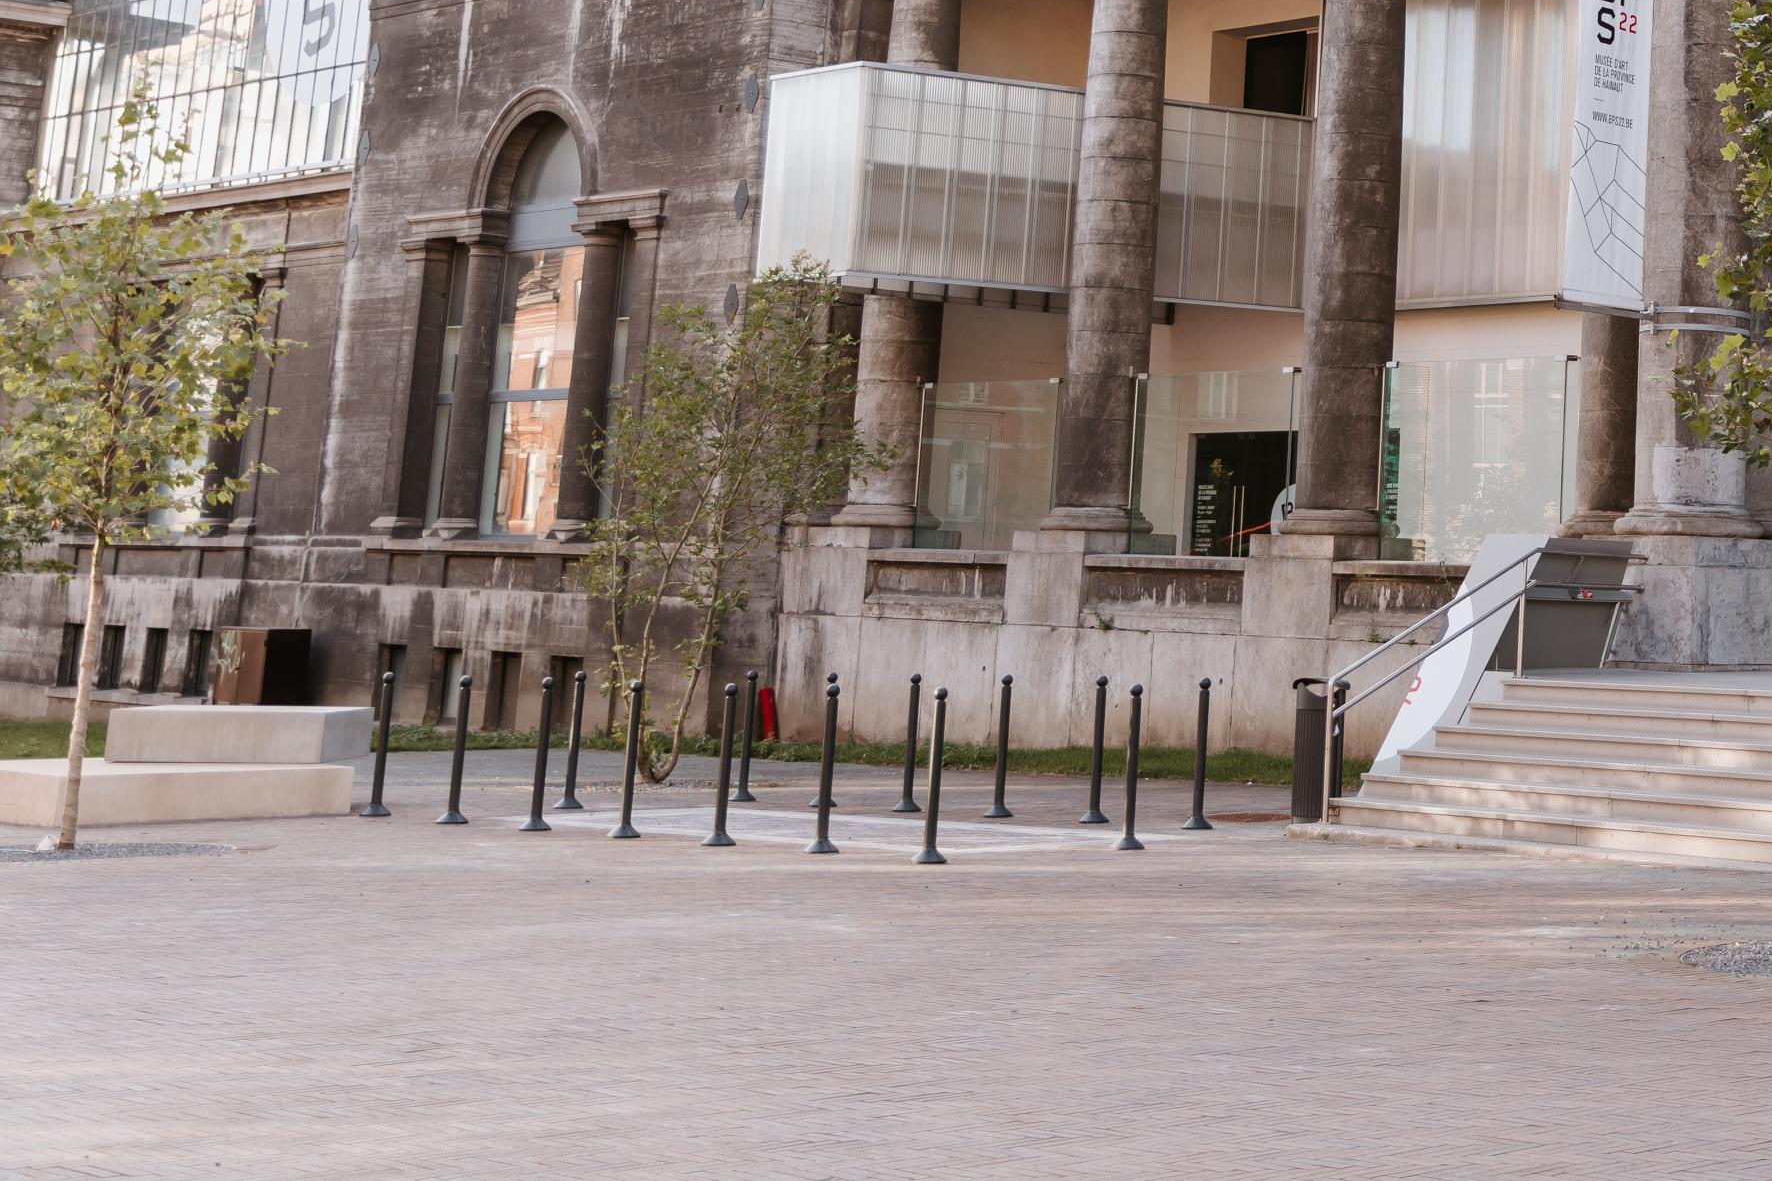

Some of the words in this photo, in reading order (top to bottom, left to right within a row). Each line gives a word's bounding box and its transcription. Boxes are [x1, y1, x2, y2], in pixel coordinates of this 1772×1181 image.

[1595, 54, 1613, 67] MUSÉE
[1614, 59, 1628, 71] D'ART
[1595, 66, 1601, 76] DE
[1603, 68, 1609, 78] LA
[1611, 70, 1635, 84] PROVINCE
[1594, 77, 1601, 88] DE
[1602, 80, 1623, 92] HAINAUT
[1592, 110, 1633, 129] WWW.BPS22.BE
